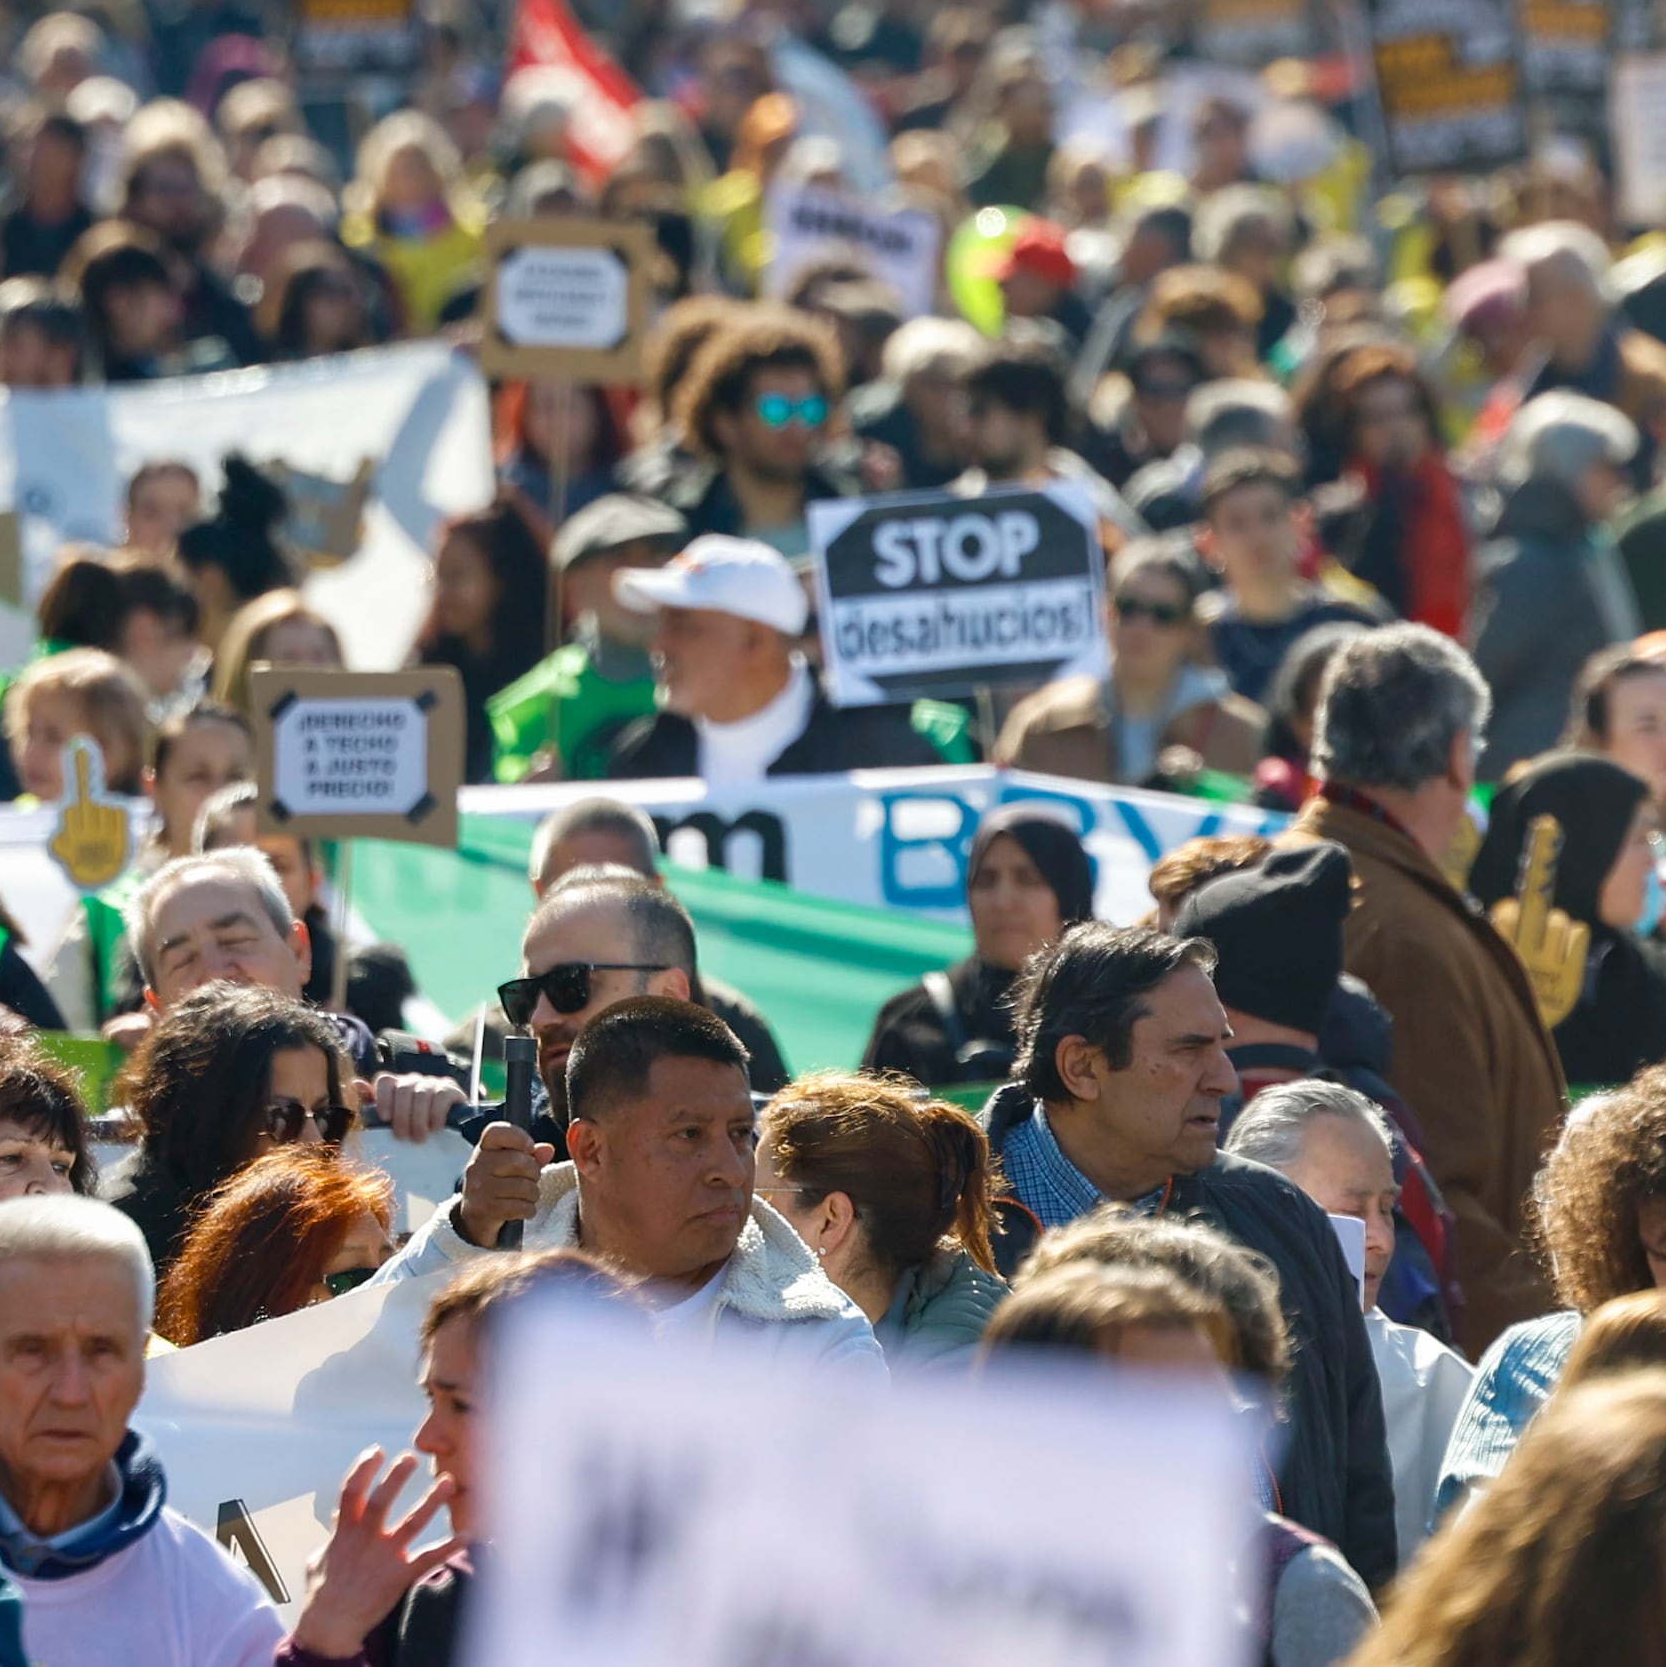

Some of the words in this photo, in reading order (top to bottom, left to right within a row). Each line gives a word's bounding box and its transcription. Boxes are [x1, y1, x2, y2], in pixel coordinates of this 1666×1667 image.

[871, 510, 1041, 588] STOP
[324, 737, 398, 754] TECHO
[327, 759, 397, 776] JUSTO
